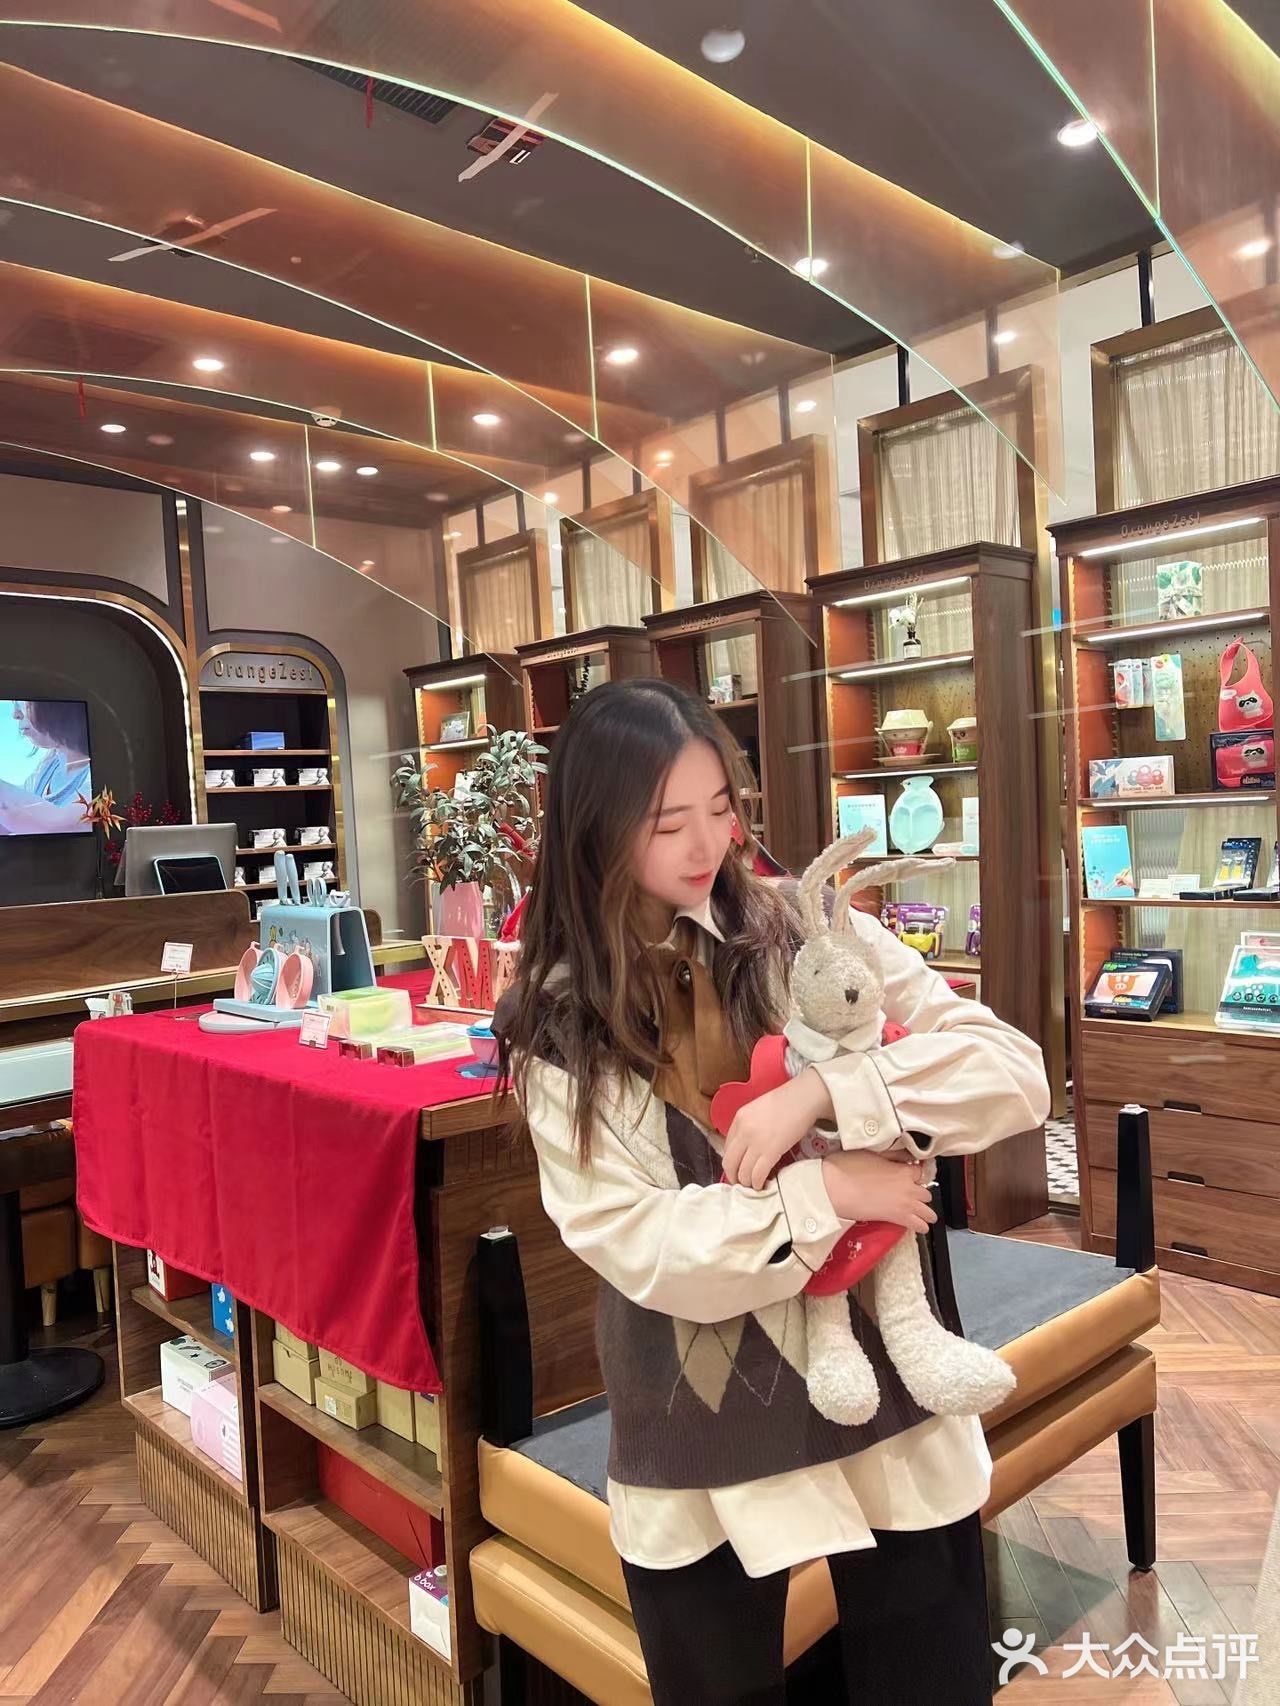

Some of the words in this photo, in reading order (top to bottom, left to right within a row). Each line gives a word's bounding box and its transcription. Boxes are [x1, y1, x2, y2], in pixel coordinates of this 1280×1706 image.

[1121, 511, 1201, 539] OrangeZest
[864, 568, 924, 591] OrangeZest
[213, 659, 313, 684] OrangeZest
